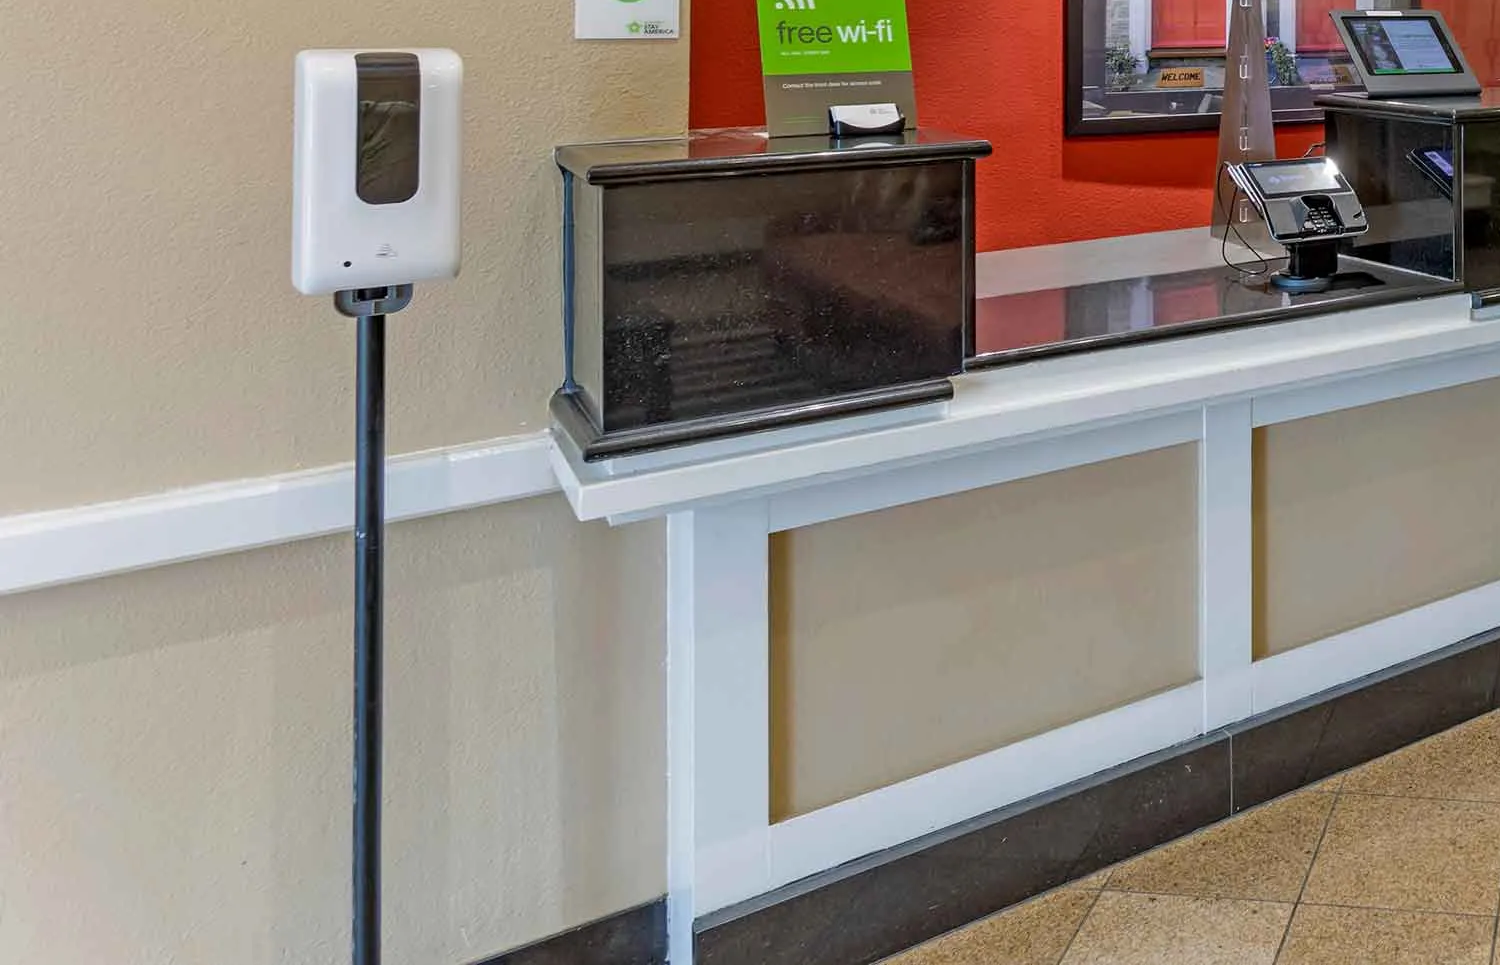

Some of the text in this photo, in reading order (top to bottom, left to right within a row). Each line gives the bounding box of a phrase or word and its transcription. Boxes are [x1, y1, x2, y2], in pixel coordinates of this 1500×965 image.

[776, 19, 894, 45] free wi-fi
[1161, 72, 1201, 81] WELCOME
